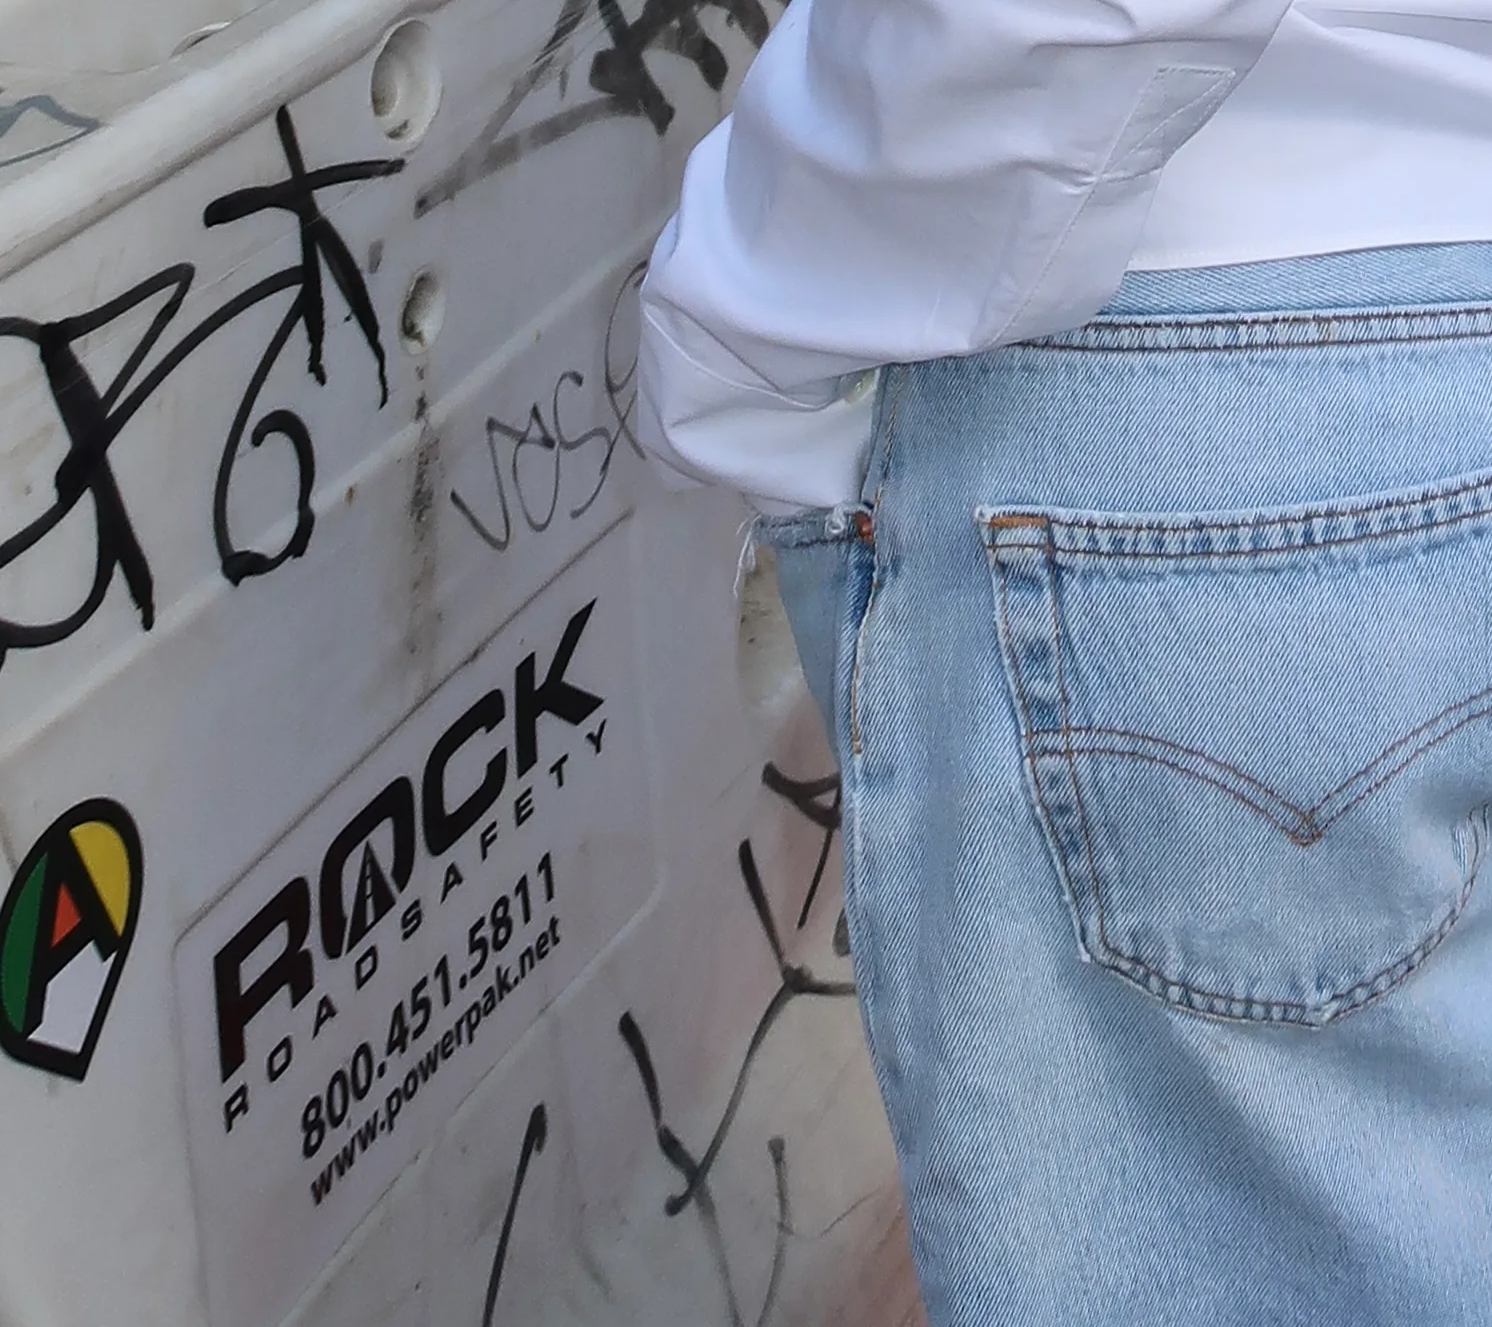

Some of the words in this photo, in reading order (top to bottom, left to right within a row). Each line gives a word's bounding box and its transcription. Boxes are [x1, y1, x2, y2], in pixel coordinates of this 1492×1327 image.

[213, 597, 604, 1083] ROCK
[302, 851, 555, 1160] 800.451.5811
[310, 915, 561, 1207] www.powerpak.net
